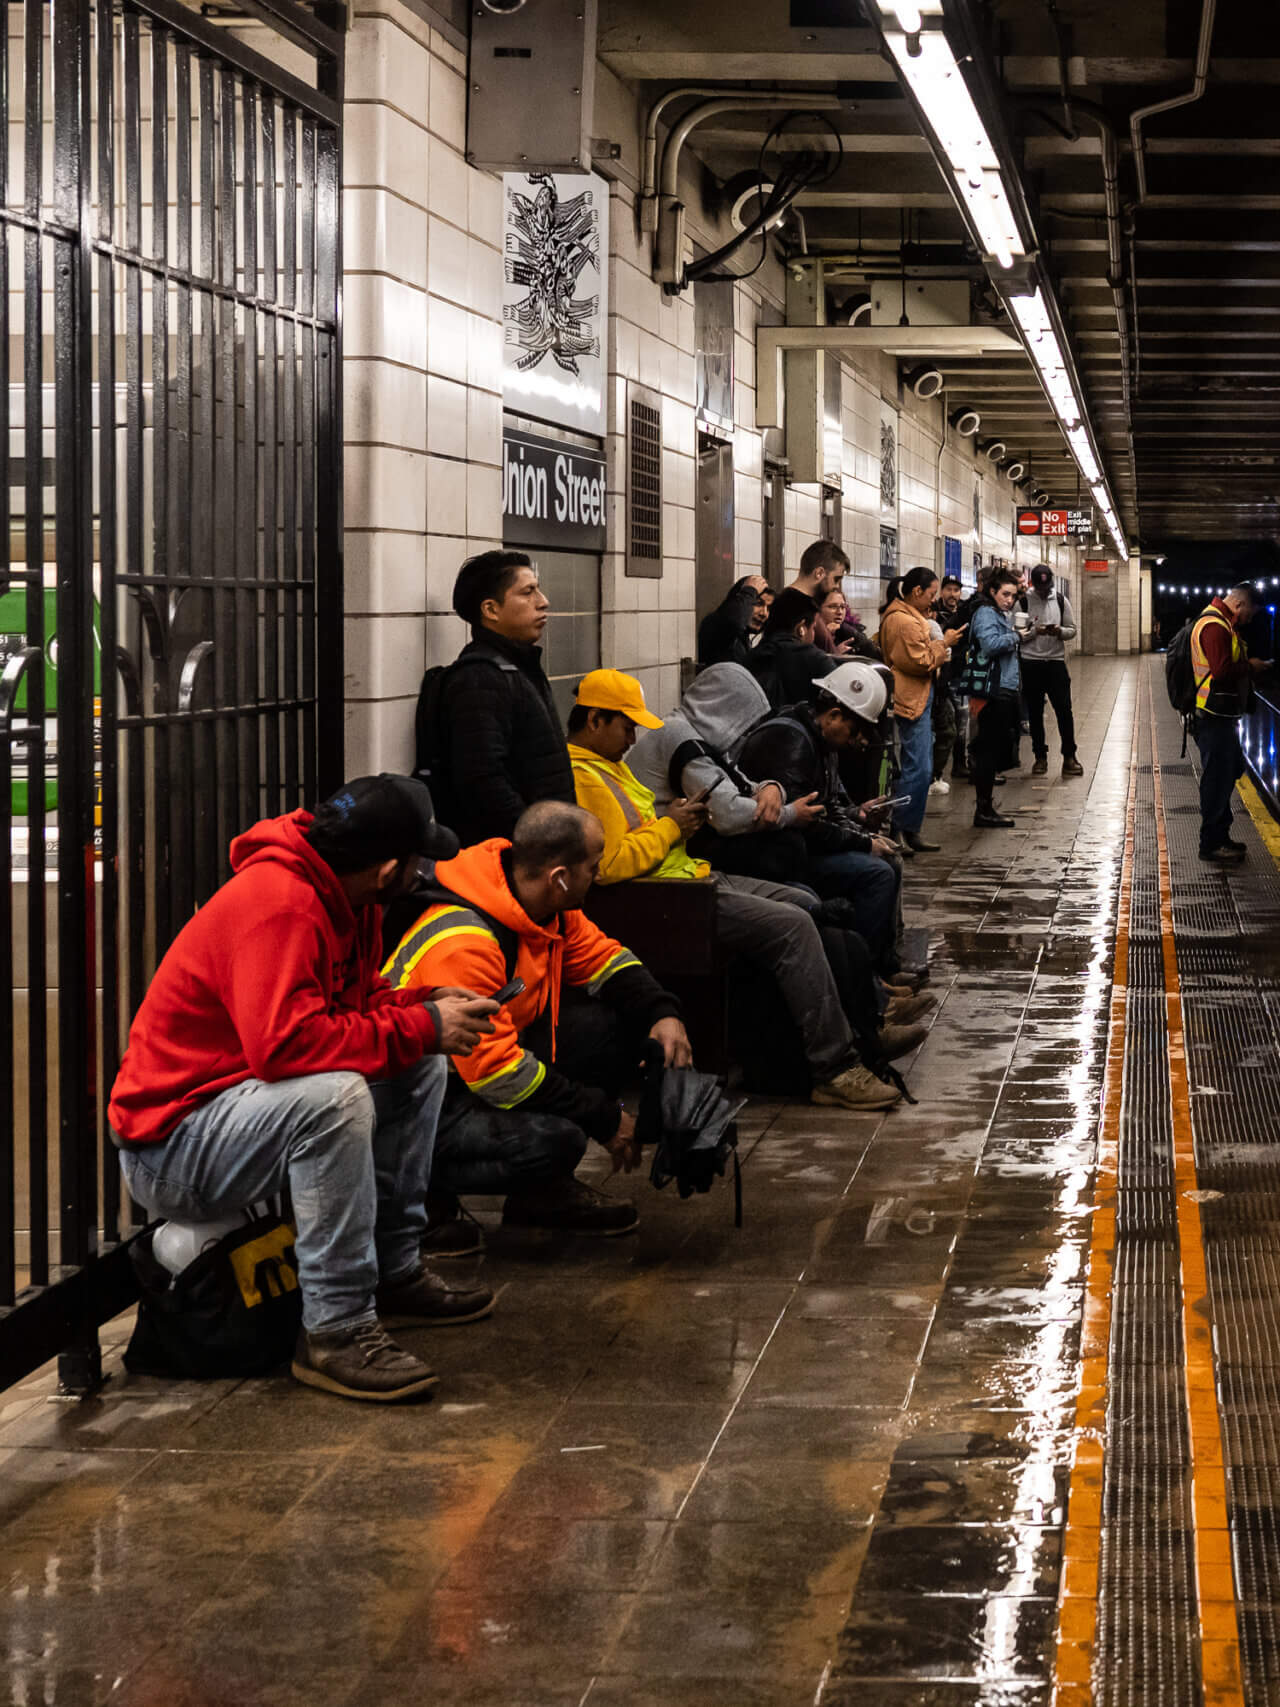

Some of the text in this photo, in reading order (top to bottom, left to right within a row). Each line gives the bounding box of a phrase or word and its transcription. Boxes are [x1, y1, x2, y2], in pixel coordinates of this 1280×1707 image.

[554, 454, 606, 526] Street
[1042, 511, 1059, 522] No
[1042, 523, 1065, 533] Exit
